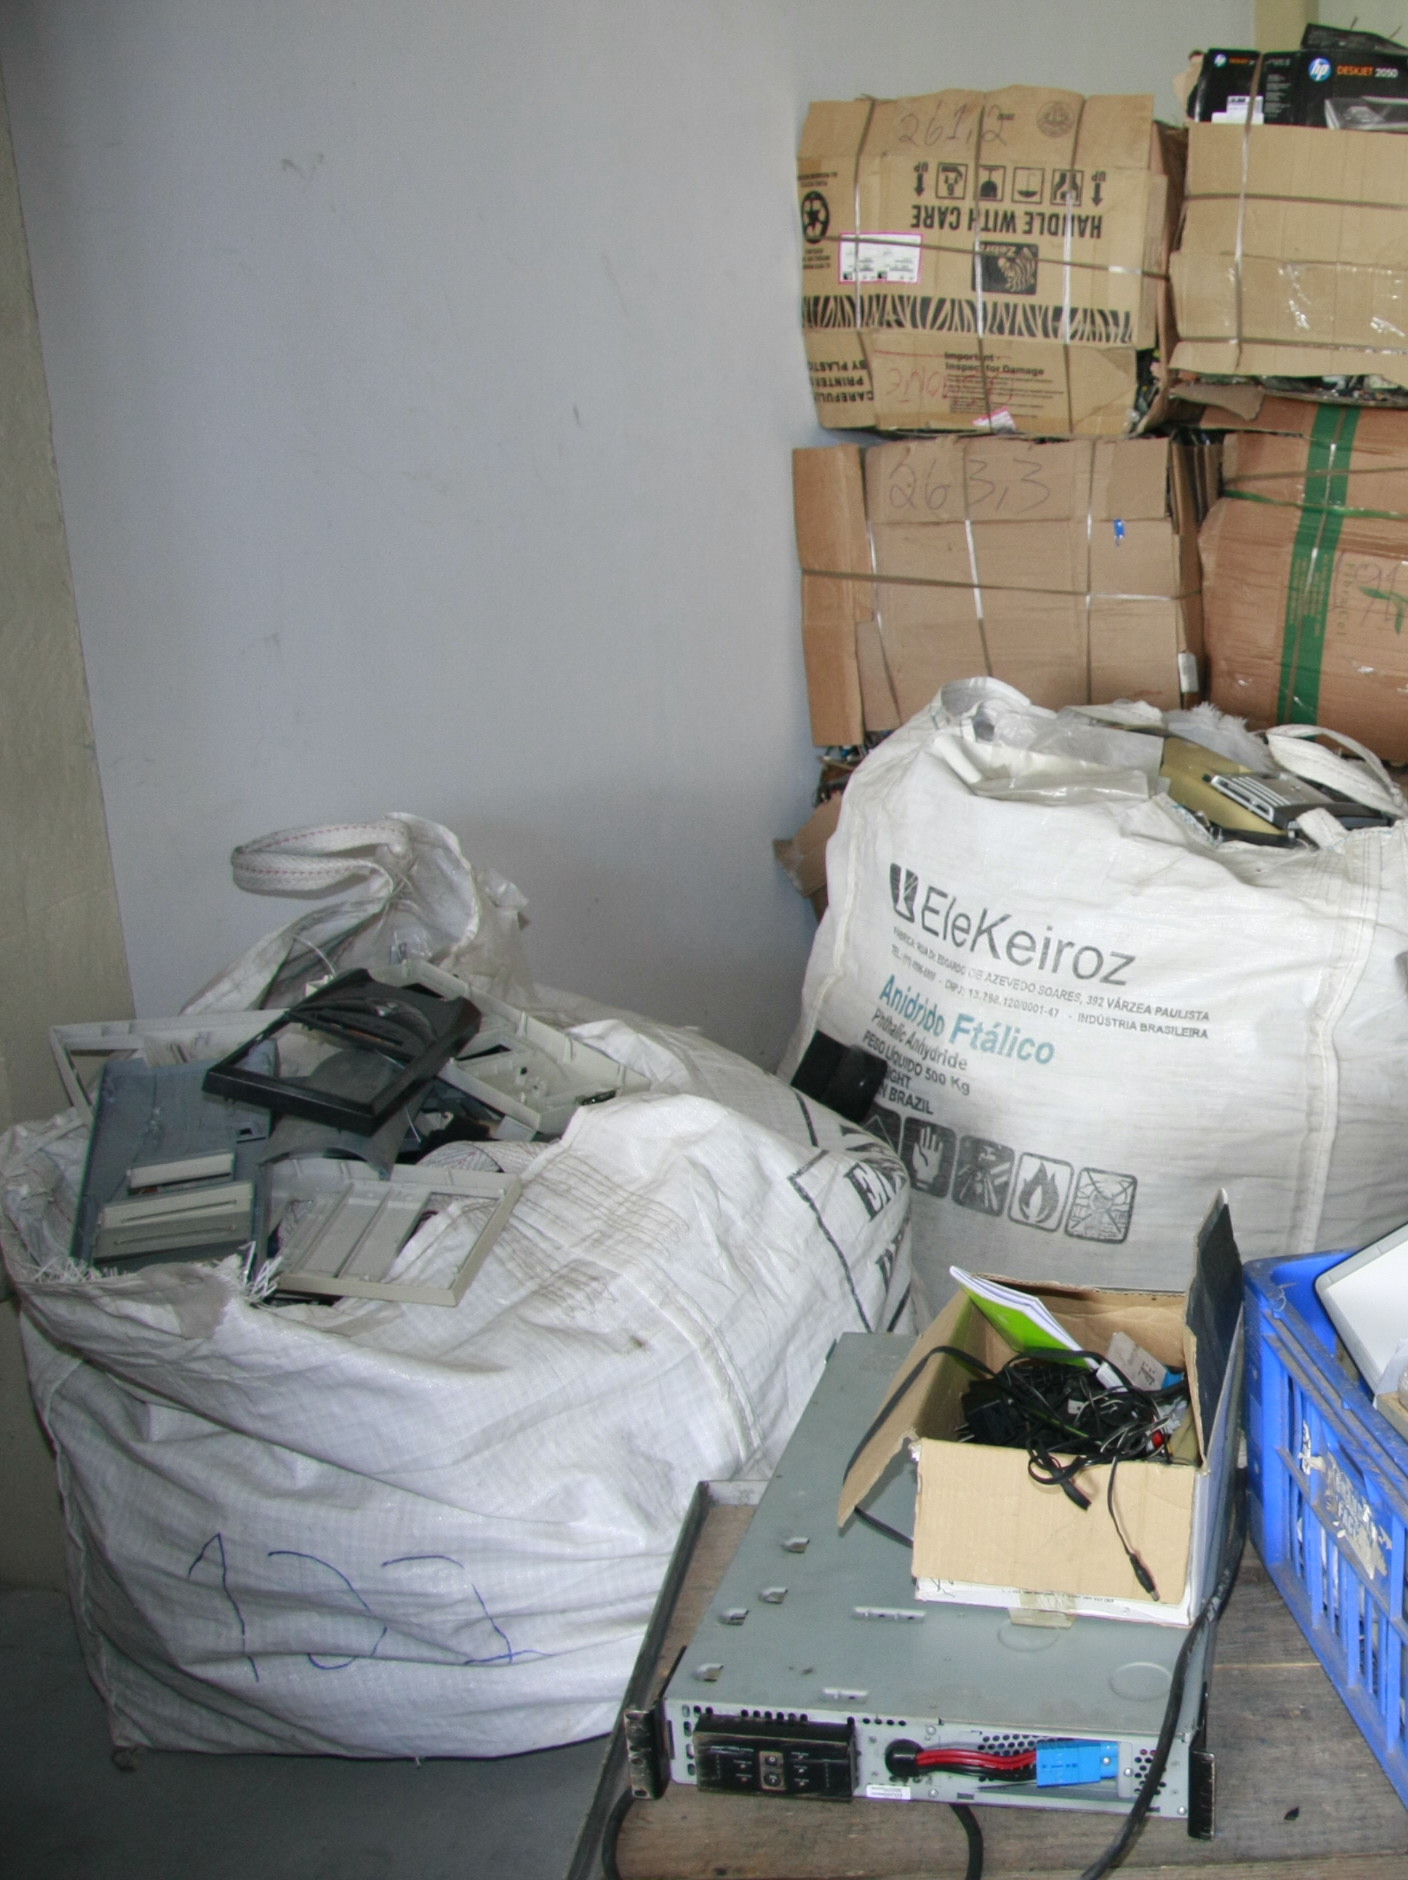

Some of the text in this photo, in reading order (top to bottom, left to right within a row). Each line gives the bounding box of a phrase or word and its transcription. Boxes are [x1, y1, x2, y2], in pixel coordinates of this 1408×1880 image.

[1309, 57, 1399, 81] hp DESKJET 2050
[913, 161, 929, 173] UP
[1091, 171, 1107, 182] UP
[910, 204, 962, 231] CARE
[985, 364, 1000, 373] for
[1002, 365, 1044, 377] Damage
[921, 885, 1136, 986] EleKeiroz
[984, 972, 1037, 993] AZEVEDO
[1038, 984, 1083, 1005] SOARES,
[1086, 994, 1104, 1008] 392
[1106, 996, 1151, 1015] VÁRZEA
[1154, 1006, 1210, 1021] PAULISTA
[879, 974, 1055, 1065] Anidrido Ftálico
[1077, 1012, 1137, 1031] INDÚSTRIA
[1140, 1023, 1208, 1039] BRASILEIRA
[863, 1030, 886, 1055] PESO
[925, 1067, 946, 1086] 500
[950, 1075, 970, 1096] Kg
[884, 1069, 912, 1090] IGHT
[889, 1087, 934, 1115] BRAZIL
